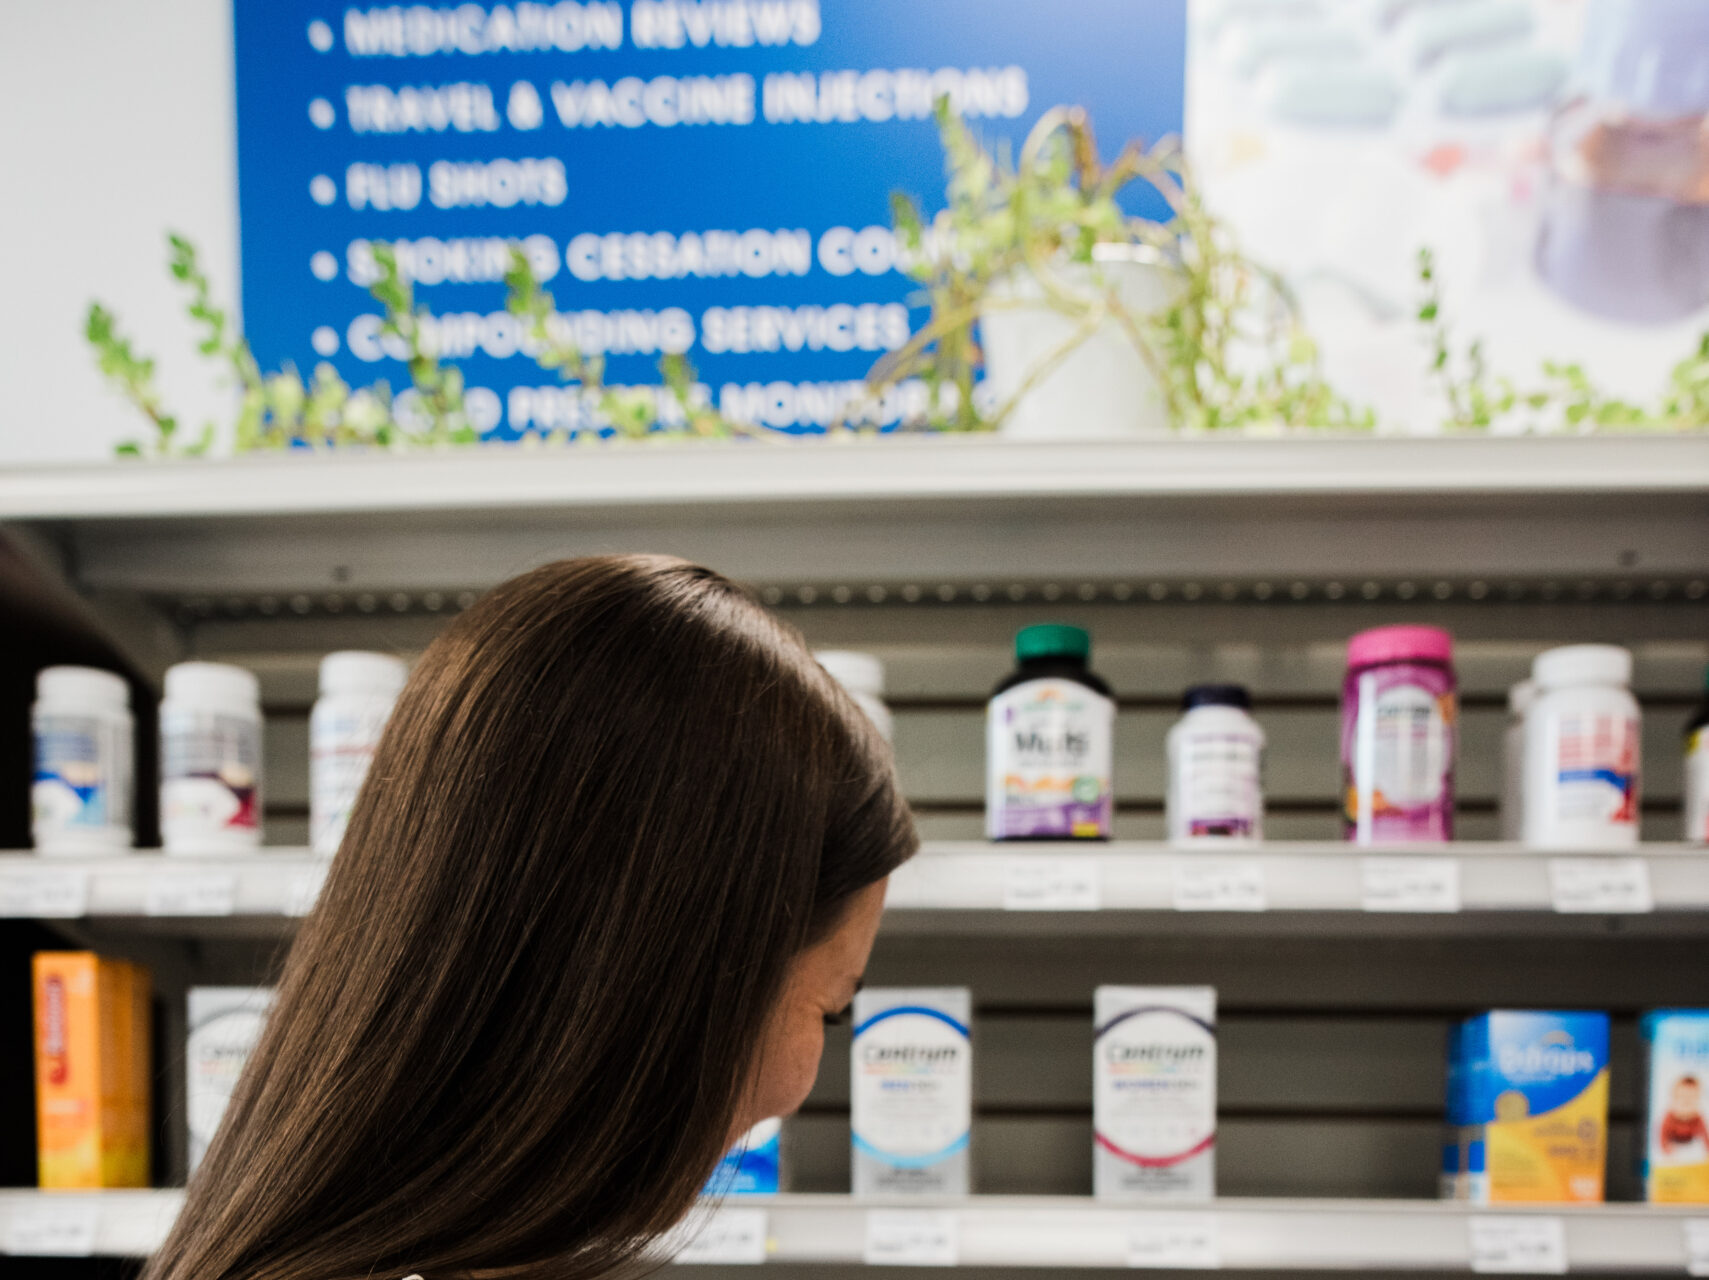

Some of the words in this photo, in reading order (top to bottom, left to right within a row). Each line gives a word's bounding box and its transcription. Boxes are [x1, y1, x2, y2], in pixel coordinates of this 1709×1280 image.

[343, 2, 623, 57] MEDICATION
[631, 0, 821, 49] REVIEWS
[346, 83, 500, 134] TRAVEL
[507, 80, 543, 130] &
[551, 72, 756, 128] VACCINE
[763, 64, 1028, 123] INJECTIONS
[346, 161, 422, 211] FLU
[429, 157, 567, 209] SHOTS
[566, 228, 812, 281] CESSATION
[701, 303, 909, 354] SERVICES
